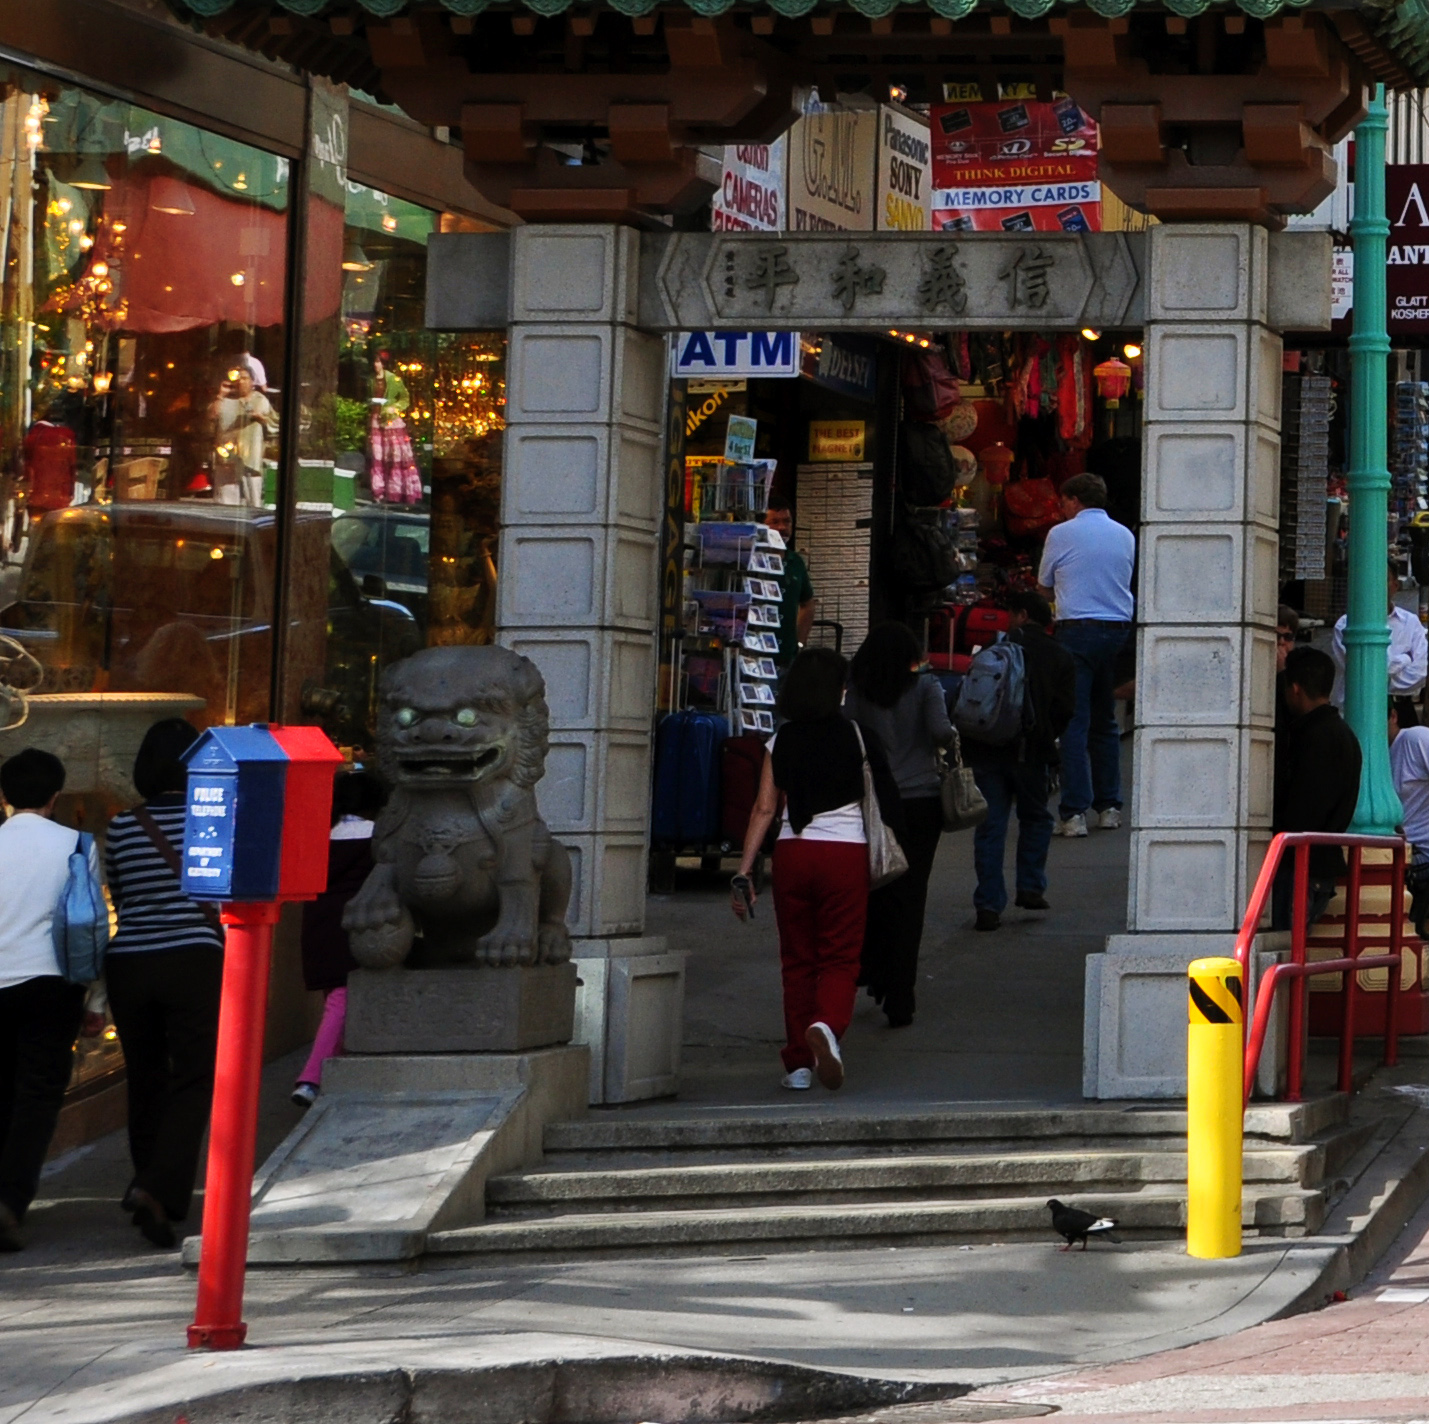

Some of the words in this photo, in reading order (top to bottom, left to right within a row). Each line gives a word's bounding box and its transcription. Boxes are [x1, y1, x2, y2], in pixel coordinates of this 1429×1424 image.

[884, 113, 928, 165] Panasonic
[890, 156, 922, 200] SONY
[954, 167, 1005, 180] THINK
[1010, 164, 1076, 177] DIGITAL
[723, 171, 778, 227] CAMERAS
[945, 188, 1024, 207] MEMORY
[1031, 184, 1090, 202] CARDS
[744, 243, 1055, 314] 信義和平
[1395, 296, 1428, 307] GLATT
[679, 332, 790, 366] ATM
[814, 428, 834, 437] THE
[836, 428, 860, 437] BEST
